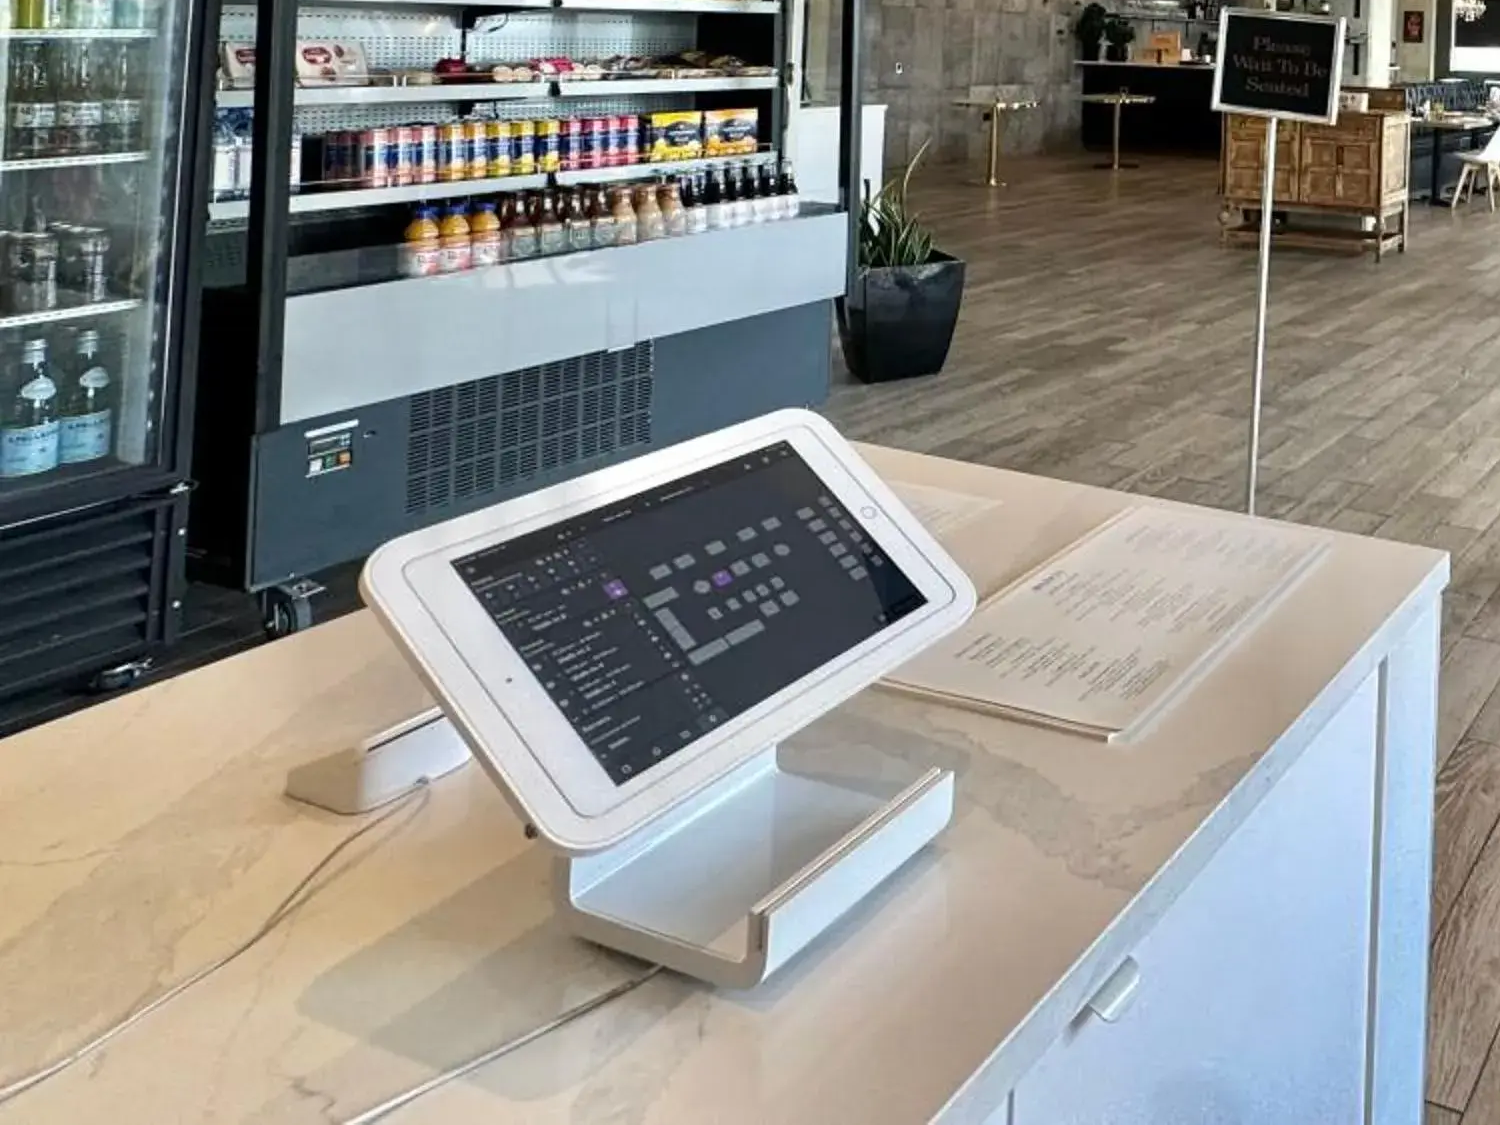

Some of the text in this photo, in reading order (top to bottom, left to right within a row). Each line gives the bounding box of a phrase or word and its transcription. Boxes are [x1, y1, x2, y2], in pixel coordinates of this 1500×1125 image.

[1254, 35, 1310, 56] Please
[1234, 53, 1328, 77] Wait To Be
[1246, 77, 1308, 96] Seated
